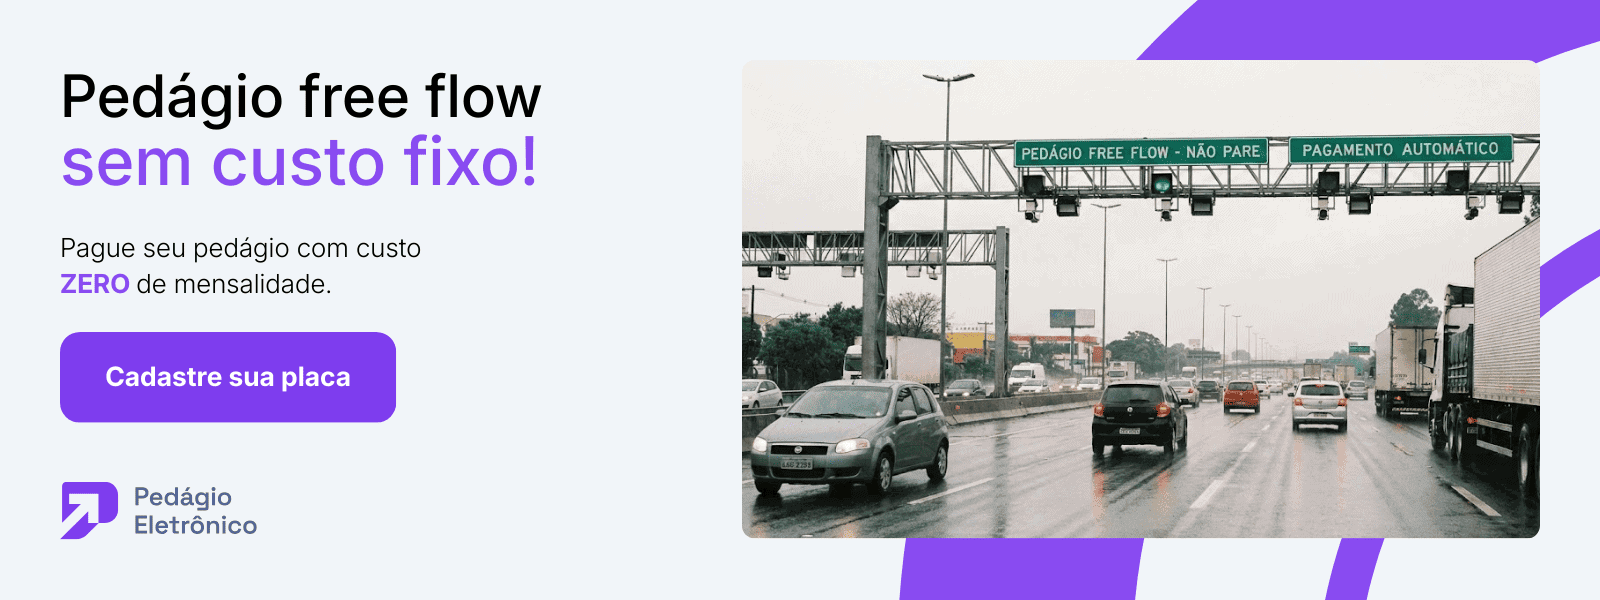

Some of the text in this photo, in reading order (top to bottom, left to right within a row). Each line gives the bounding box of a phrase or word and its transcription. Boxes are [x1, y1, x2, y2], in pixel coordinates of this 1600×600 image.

[1022, 144, 1082, 160] PEDÁGIO
[1089, 147, 1124, 160] FREE
[1131, 146, 1169, 159] FLOW
[1186, 143, 1216, 159] NÃO
[1223, 145, 1261, 158] PARE
[1303, 140, 1499, 157] PAGAMENTO AUTOMÁTICO
